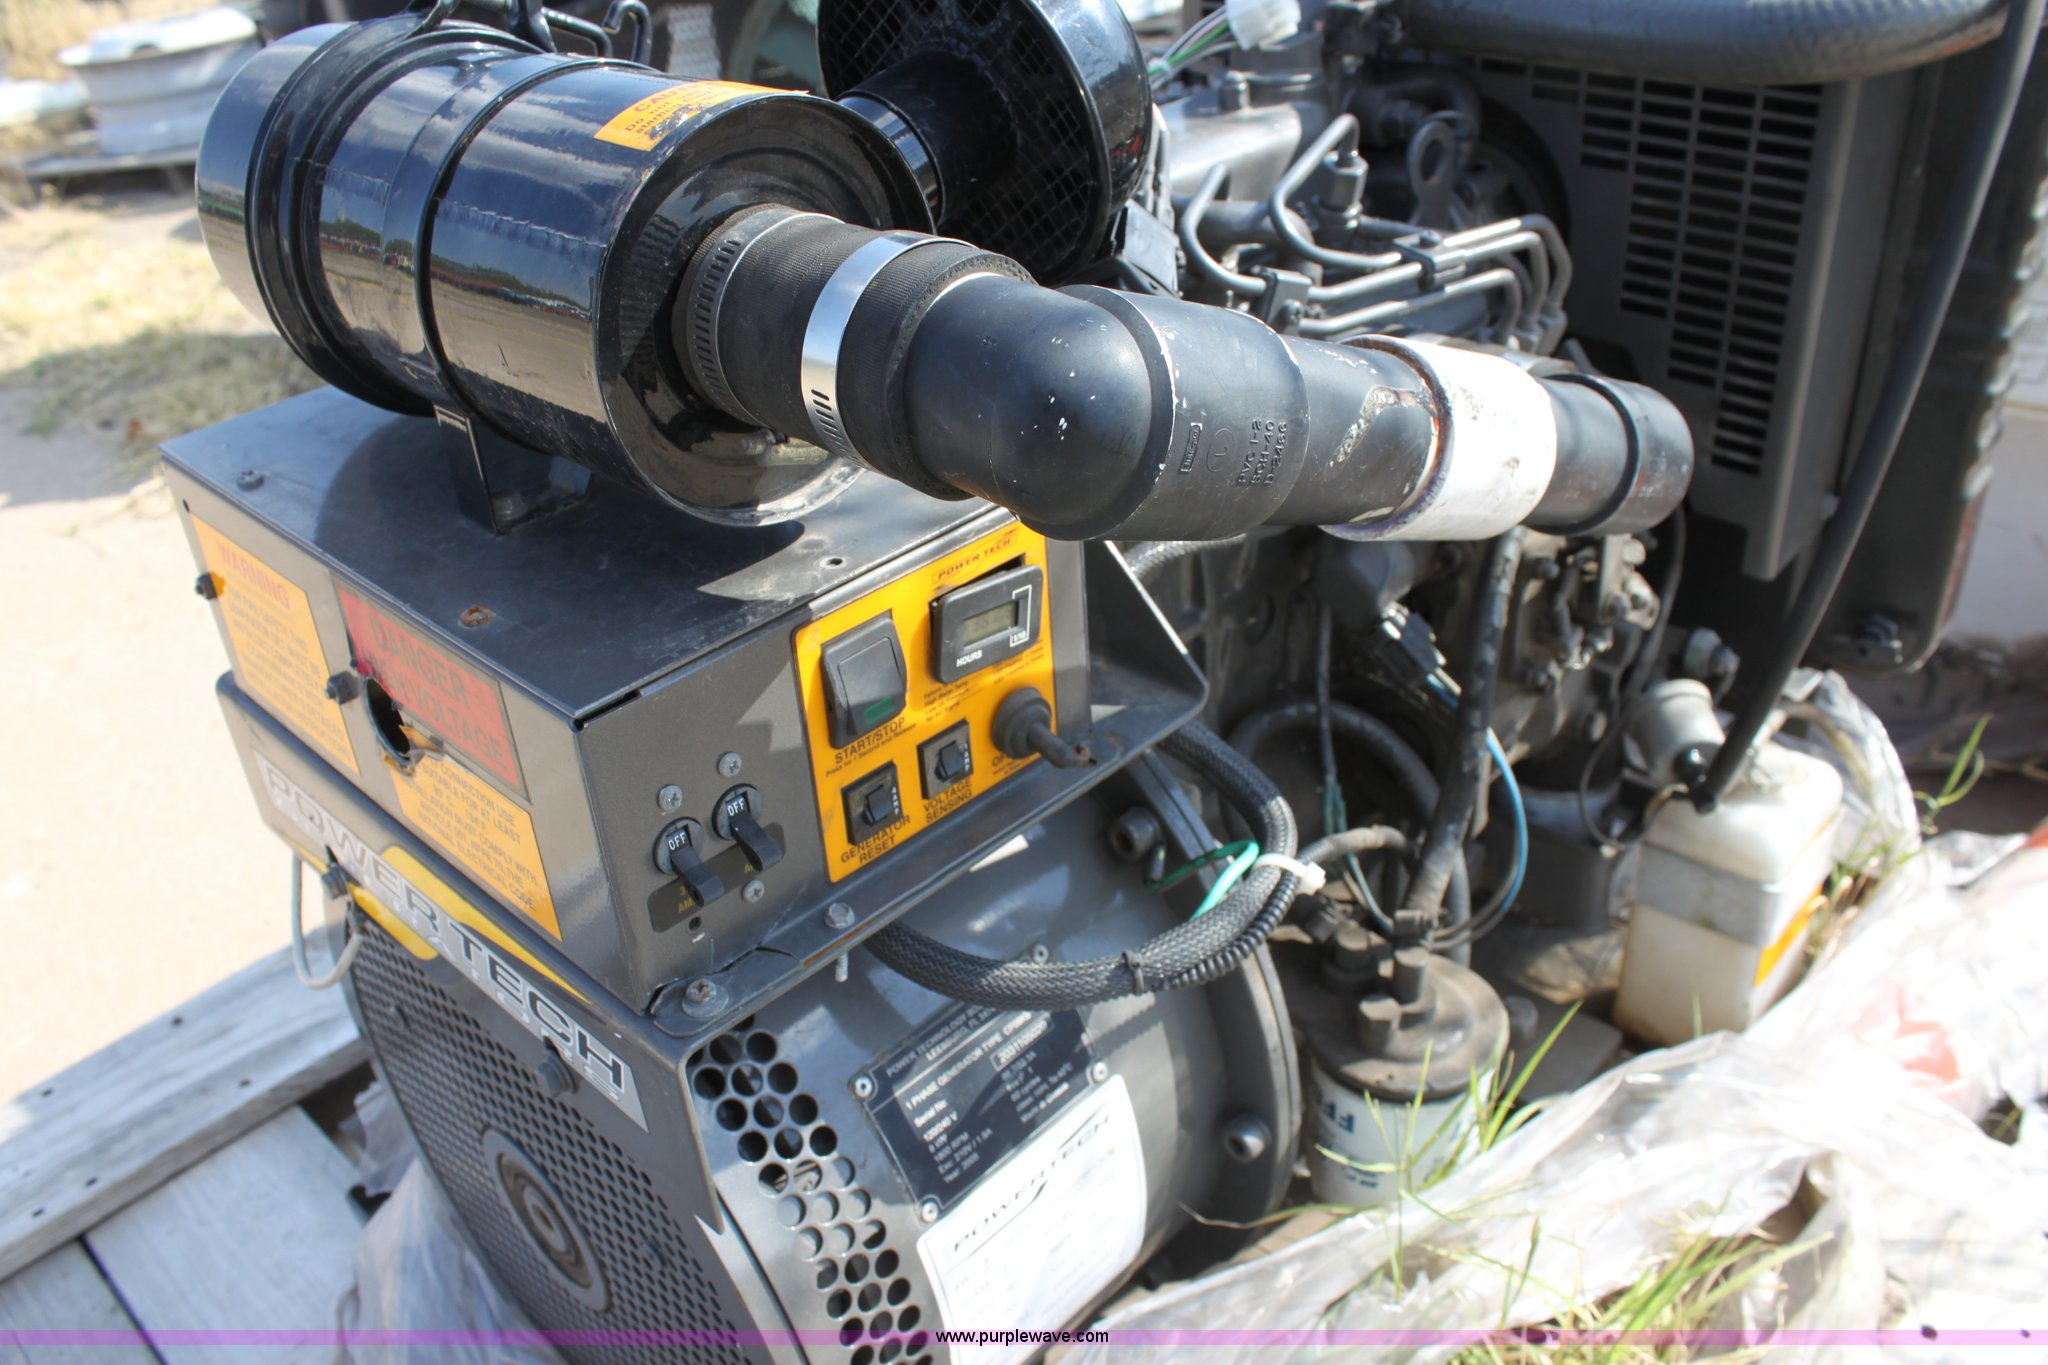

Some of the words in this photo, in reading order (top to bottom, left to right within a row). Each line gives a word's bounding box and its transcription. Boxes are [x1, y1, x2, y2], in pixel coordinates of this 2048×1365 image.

[625, 118, 644, 131] Do
[1238, 446, 1256, 484] PVC
[1250, 419, 1275, 485] SCH-40
[217, 539, 291, 610] WARNING
[938, 555, 980, 579] POWER
[983, 538, 1012, 556] TECH
[370, 612, 471, 710] DANGER
[956, 649, 983, 668] HOURS
[410, 678, 511, 772] VOLTAGE
[835, 717, 905, 764] START/STOP
[727, 798, 746, 817] OFF
[923, 779, 972, 812] VOLTAGE
[925, 789, 973, 824] SENSING
[668, 833, 687, 851] OFF
[840, 814, 911, 864] GENERATOR
[859, 836, 896, 865] RESET
[264, 761, 440, 933] POWER
[447, 914, 626, 1094] TECH
